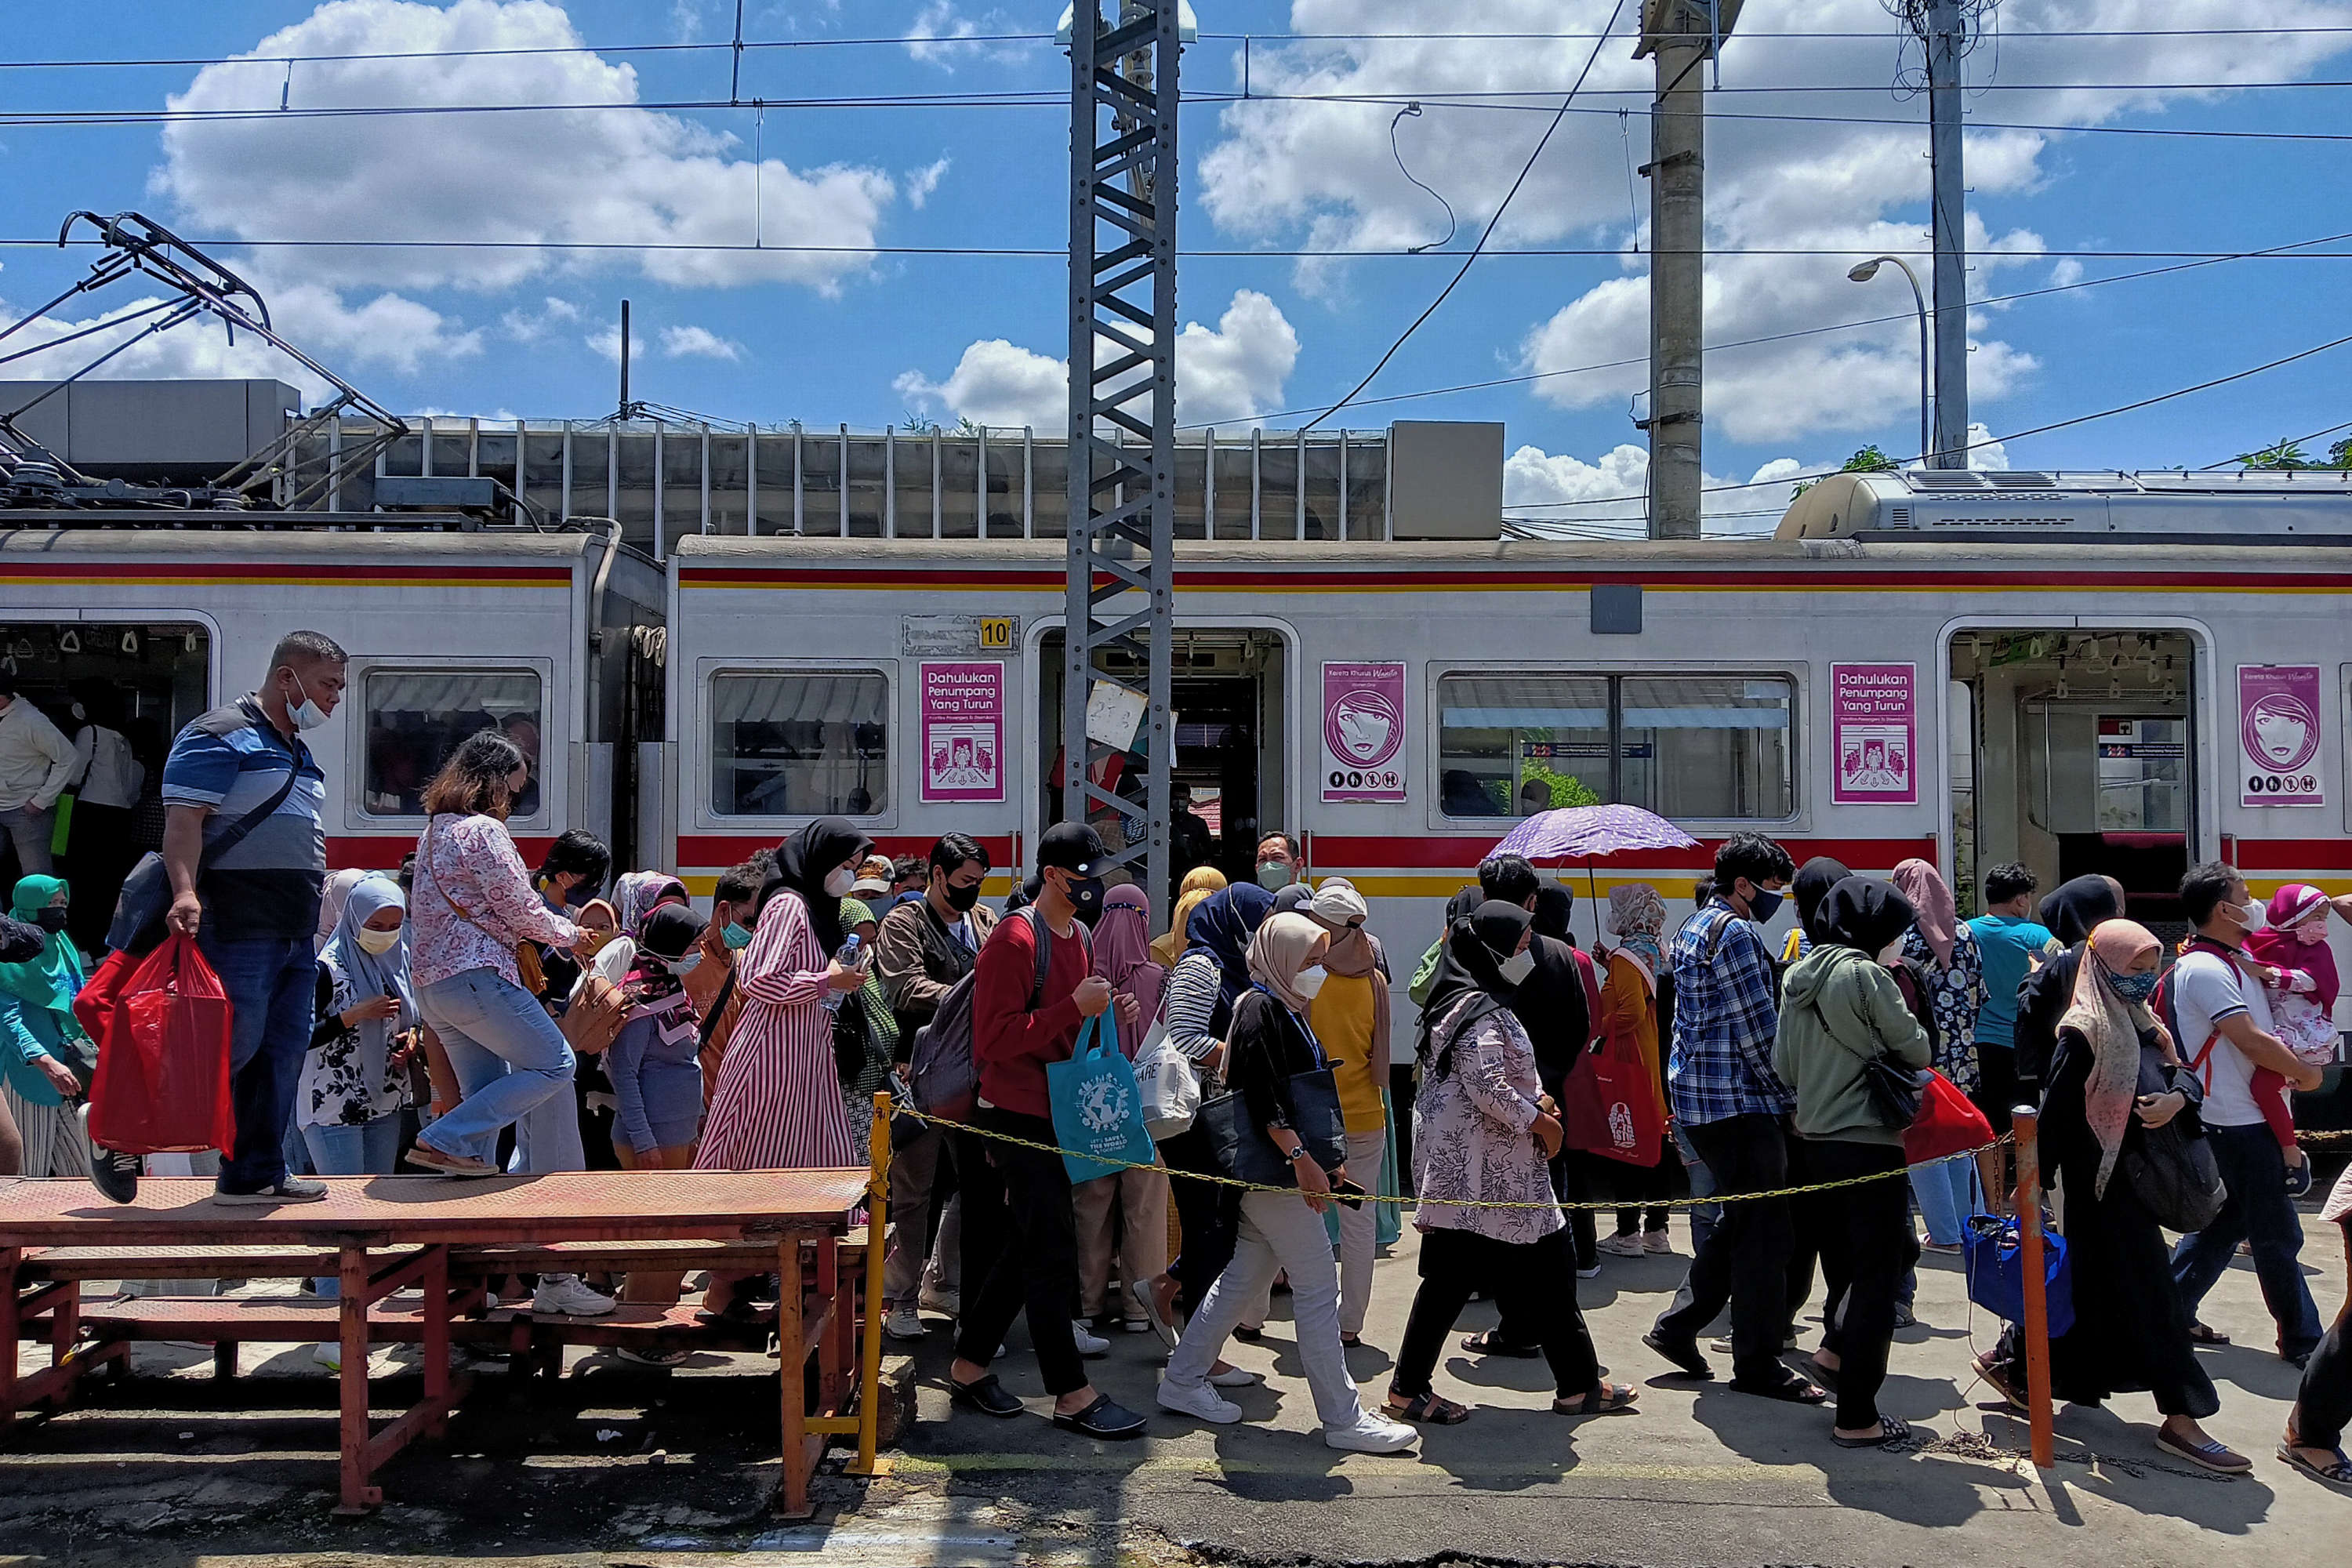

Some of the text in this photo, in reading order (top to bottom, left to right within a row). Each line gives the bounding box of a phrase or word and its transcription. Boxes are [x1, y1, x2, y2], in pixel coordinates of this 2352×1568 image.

[985, 622, 1007, 643] 10
[928, 672, 996, 684] Dahulukan
[1839, 673, 1908, 684] Dahulukan
[928, 687, 996, 699] Penumpang
[1839, 688, 1908, 700] Penumpang
[930, 699, 993, 712] Yang Turun
[1842, 700, 1905, 713] Yang Turun
[1103, 1138, 1128, 1149] WORLD
